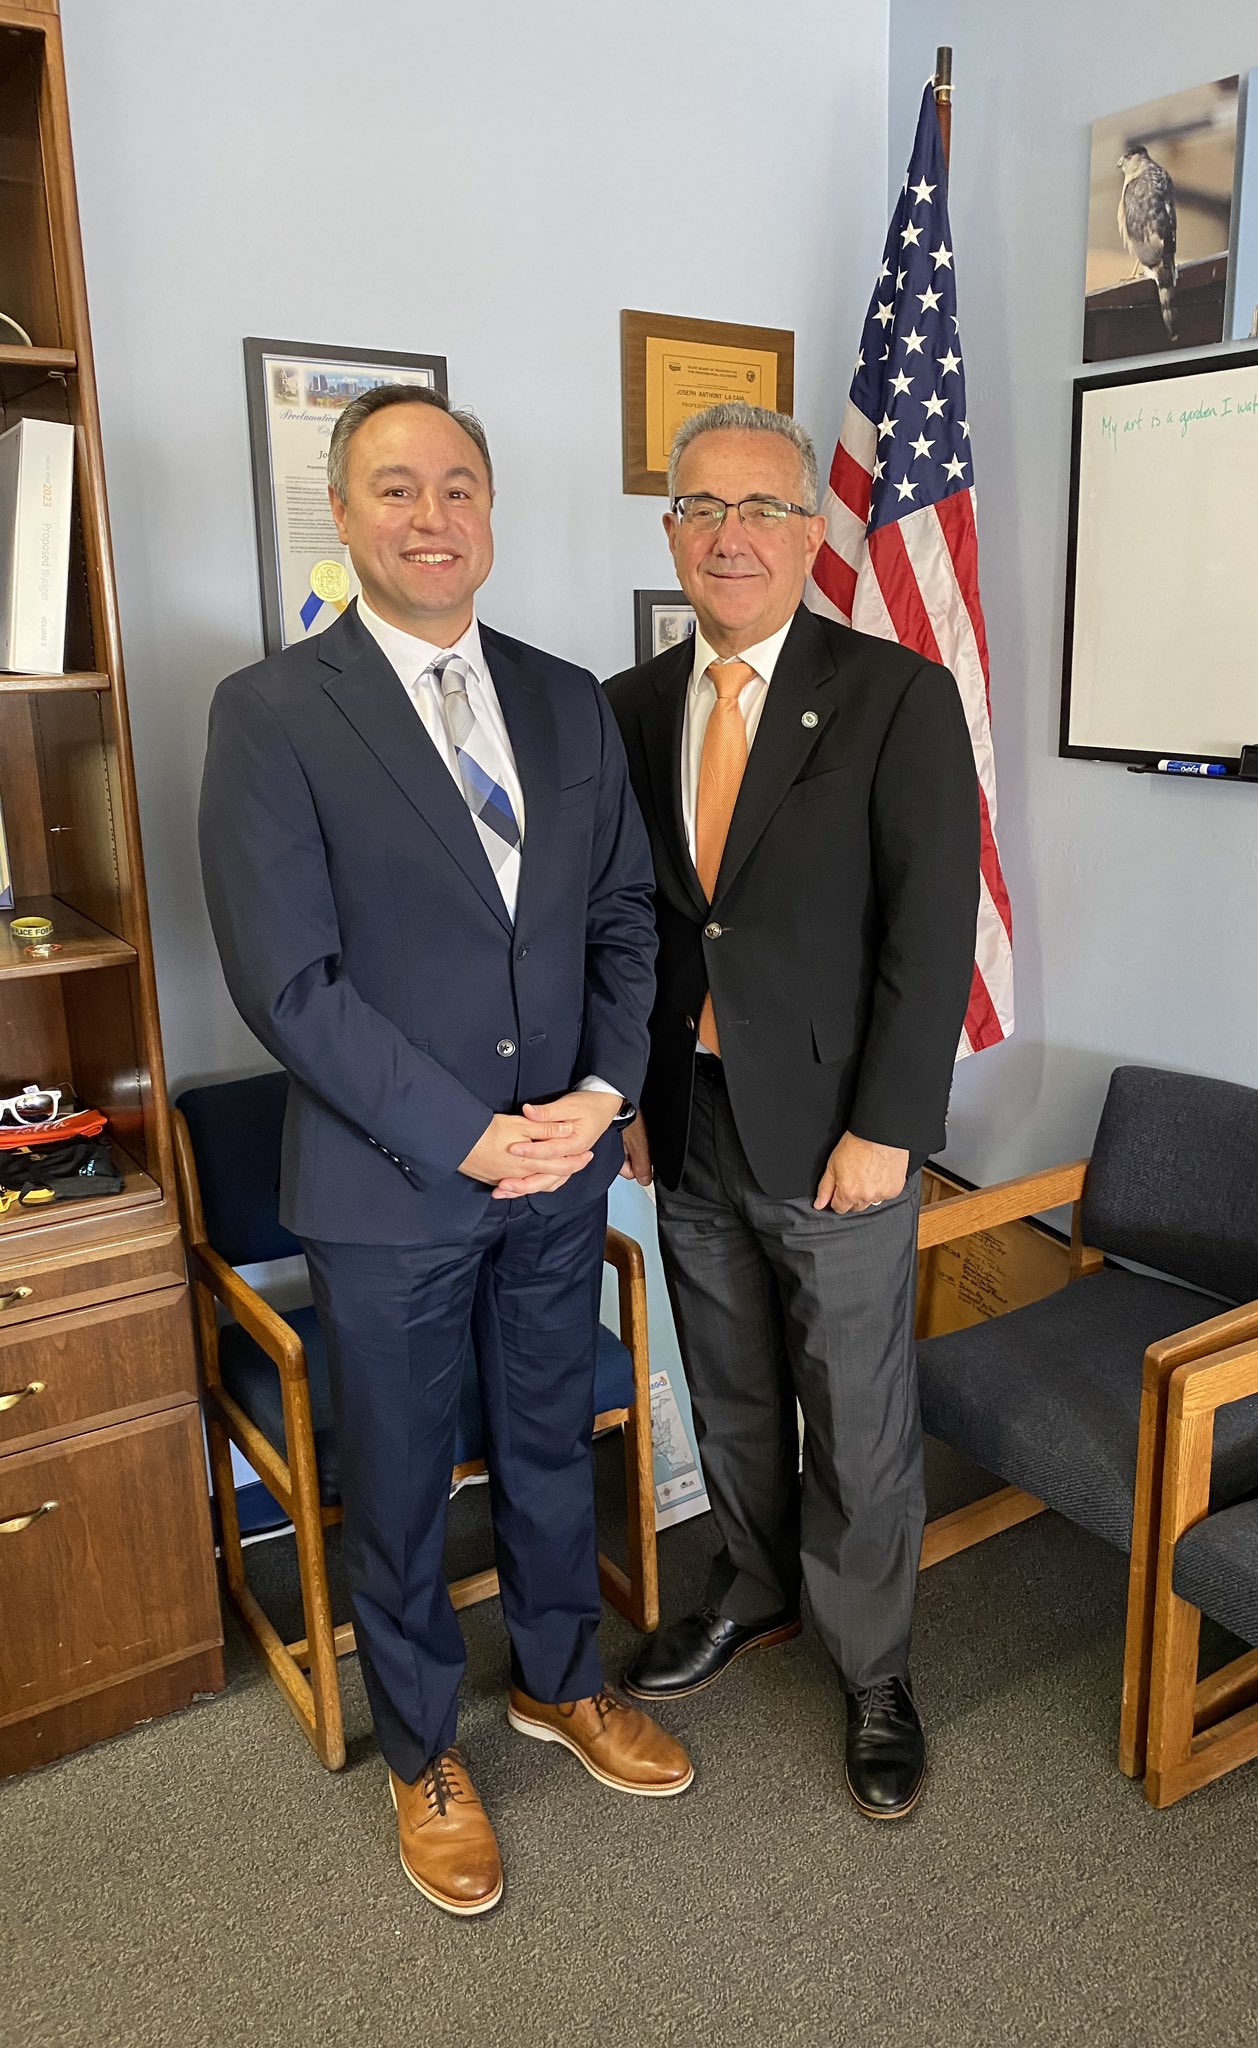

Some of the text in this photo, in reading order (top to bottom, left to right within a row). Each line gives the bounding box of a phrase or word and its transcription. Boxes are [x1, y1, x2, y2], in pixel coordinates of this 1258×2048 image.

[676, 389, 697, 397] JOSEPH
[699, 391, 722, 399] ANTHONY
[1101, 416, 1118, 453] My
[1124, 408, 1143, 432] art
[1151, 409, 1161, 428] is
[1167, 411, 1174, 424] a
[1179, 400, 1218, 438] garden
[1220, 397, 1233, 417] I
[317, 450, 329, 460] Jo
[42, 482, 52, 508] 2023
[40, 522, 52, 567] Proposed
[39, 568, 52, 602] Budget
[650, 1380, 665, 1390] EGO
